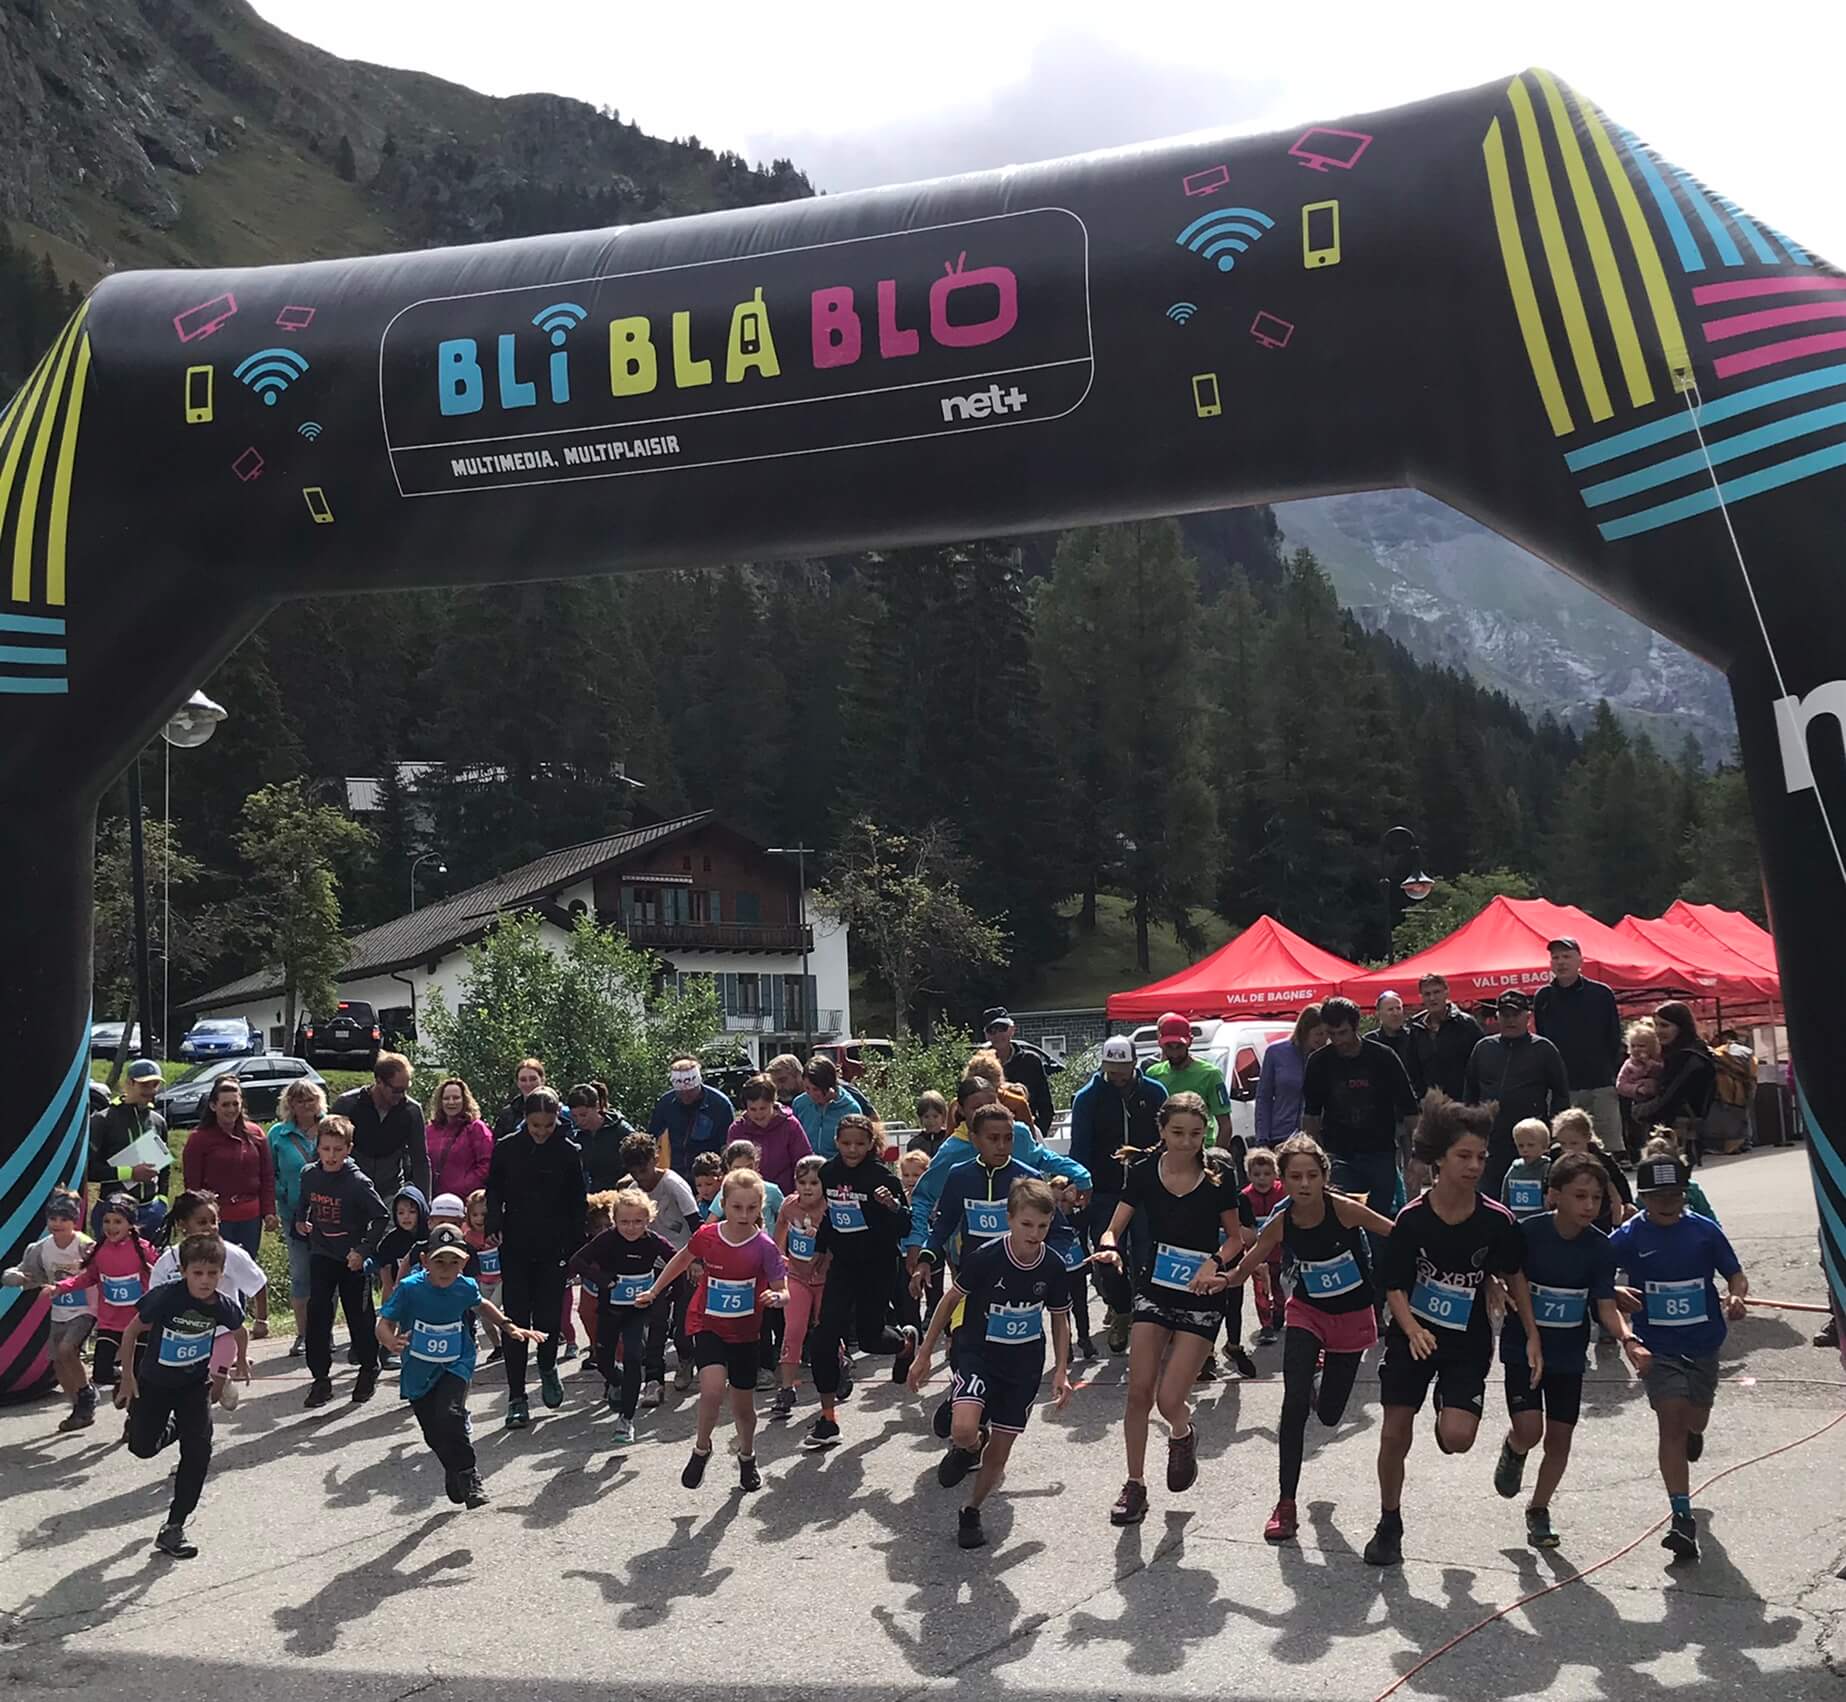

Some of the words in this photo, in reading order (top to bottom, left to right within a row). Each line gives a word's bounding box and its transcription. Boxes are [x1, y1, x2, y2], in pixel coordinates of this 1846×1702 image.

[941, 384, 1028, 422] net+
[451, 450, 559, 477] MULTIMEDIA,
[563, 435, 680, 465] MULTIPLAISIR
[1472, 977, 1498, 988] VAL
[1500, 975, 1518, 985] DE
[1226, 993, 1248, 1004] VAL
[1250, 992, 1265, 1003] DE
[1515, 1191, 1529, 1203] 86
[836, 1213, 851, 1225] 59
[979, 1215, 998, 1229] 60
[792, 1239, 807, 1252] 88
[483, 1259, 497, 1270] 77
[1170, 1262, 1192, 1281] 72
[1320, 1272, 1341, 1288] 81
[111, 1288, 129, 1299] 79
[721, 1295, 741, 1308] 75
[1428, 1297, 1452, 1317] 80
[1666, 1298, 1690, 1315] 85
[1544, 1302, 1565, 1318] 71
[1006, 1321, 1028, 1336] 92
[176, 1346, 197, 1359] 66
[427, 1340, 448, 1353] 99
